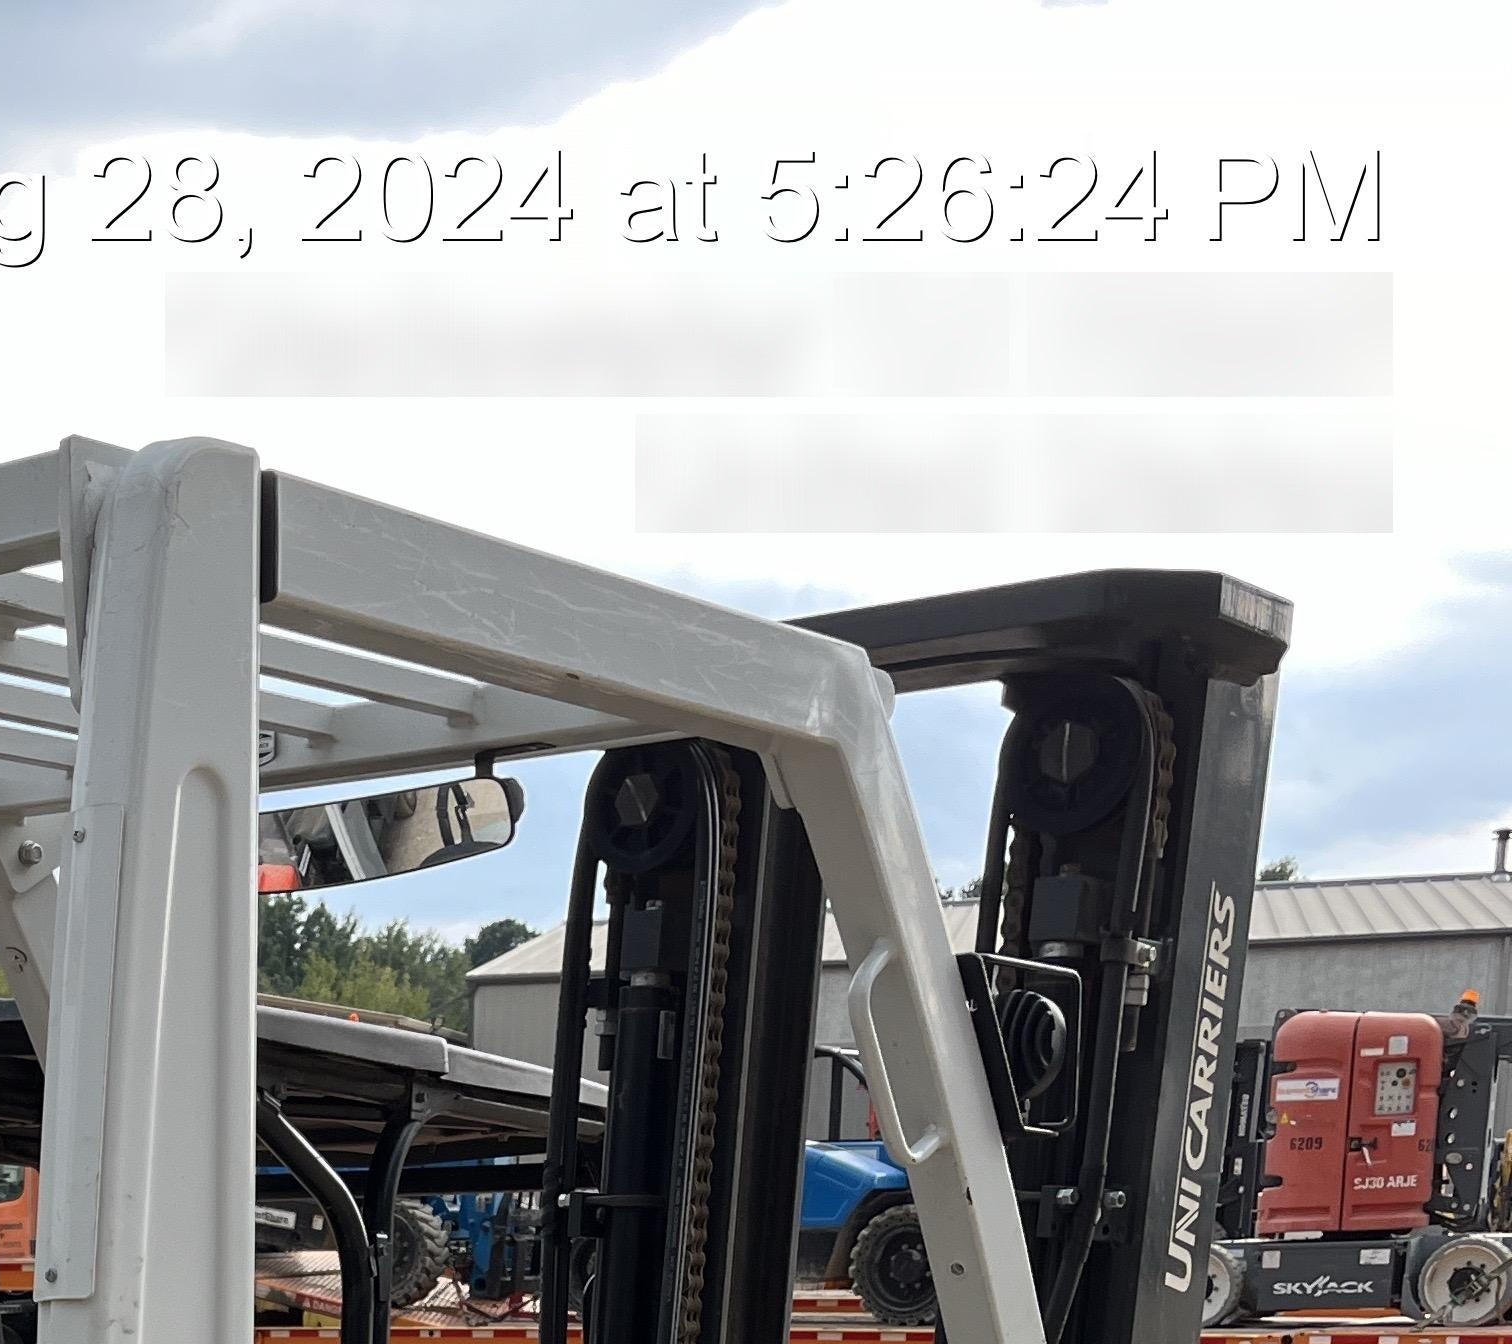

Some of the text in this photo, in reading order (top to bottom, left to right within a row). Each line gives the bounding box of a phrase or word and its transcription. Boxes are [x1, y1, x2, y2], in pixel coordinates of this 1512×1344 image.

[1163, 888, 1238, 1295] UNICARRIERS
[1289, 1135, 1324, 1151] 6209
[1417, 1136, 1434, 1153] 62
[1352, 1174, 1419, 1191] SJ30 ARJE
[1272, 1275, 1375, 1297] SKYJACK
